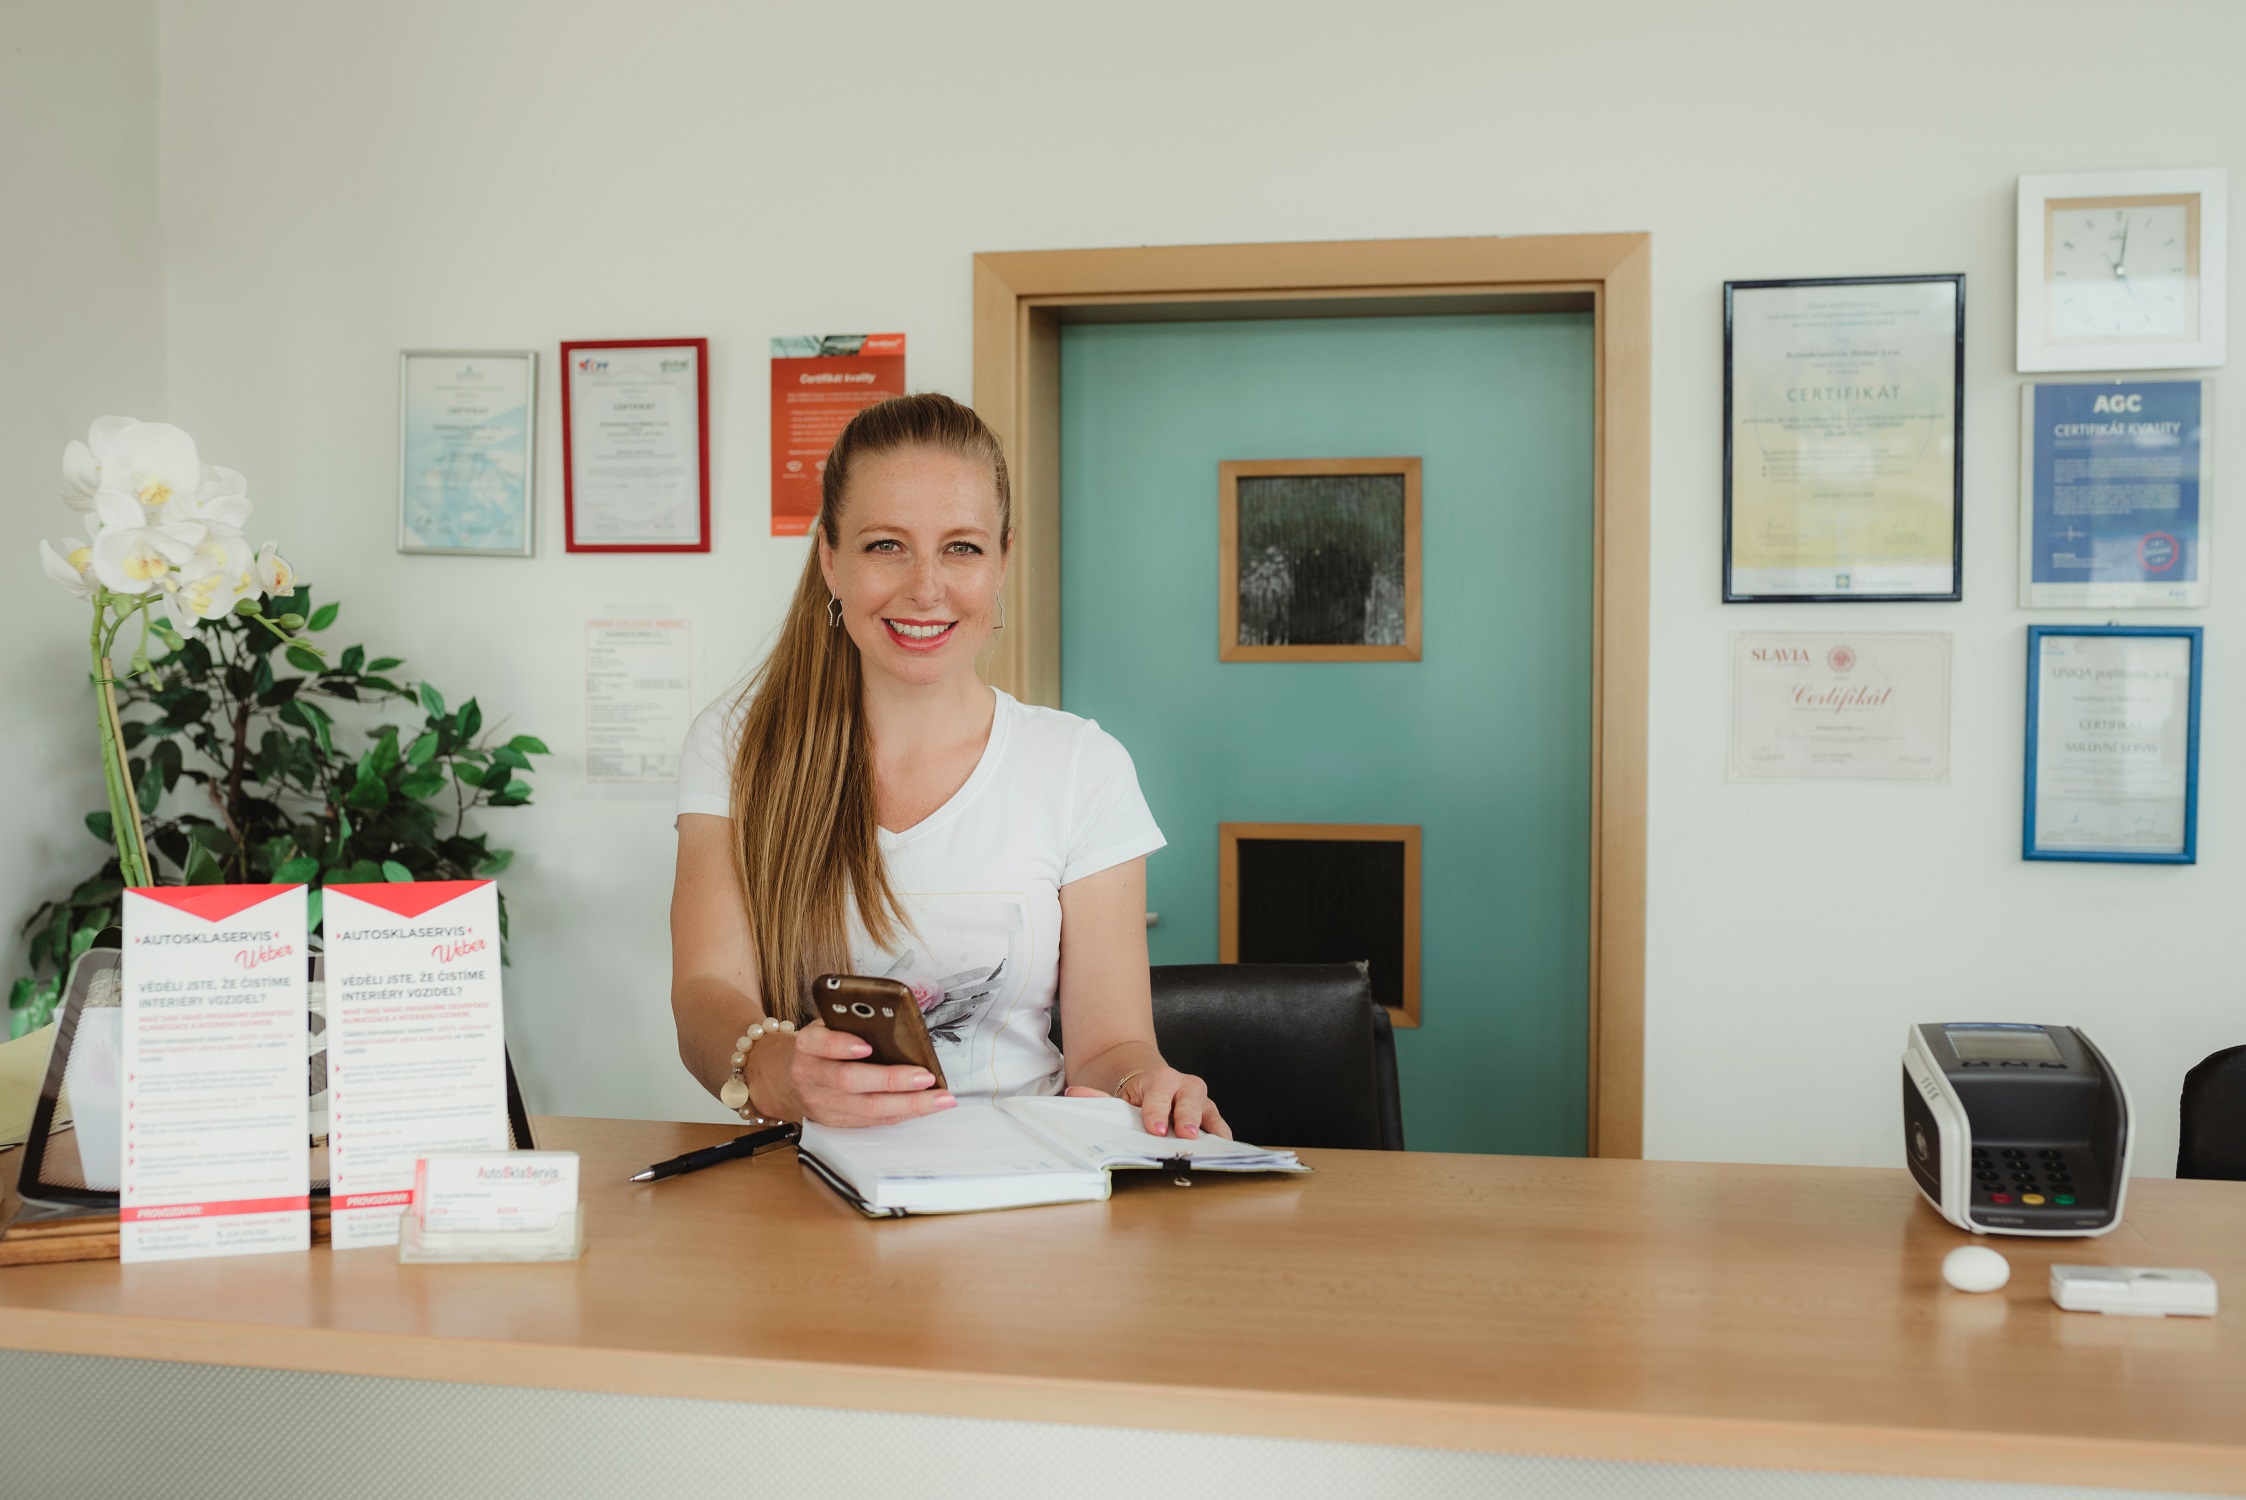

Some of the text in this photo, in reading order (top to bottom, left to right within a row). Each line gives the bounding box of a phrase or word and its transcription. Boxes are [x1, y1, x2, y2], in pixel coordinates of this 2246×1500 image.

[2093, 394, 2142, 413] AGC
[2053, 420, 2181, 437] CERTIFIKÁT KVALITY
[1751, 648, 1810, 662] SLAVIA
[141, 931, 273, 946] AUTOSKLASERVIS
[342, 926, 466, 941] AUTOSKLASERVIS
[234, 944, 294, 970] Weber
[431, 939, 487, 964] Weber
[419, 971, 434, 983] ŽE
[437, 969, 486, 982] ČISTÍME
[138, 992, 267, 1009] INTERIÉRY VOZIDEL?
[341, 986, 463, 1002] INTERIÉRY VOZIDEL?
[477, 1165, 560, 1179] AutoSklaServis
